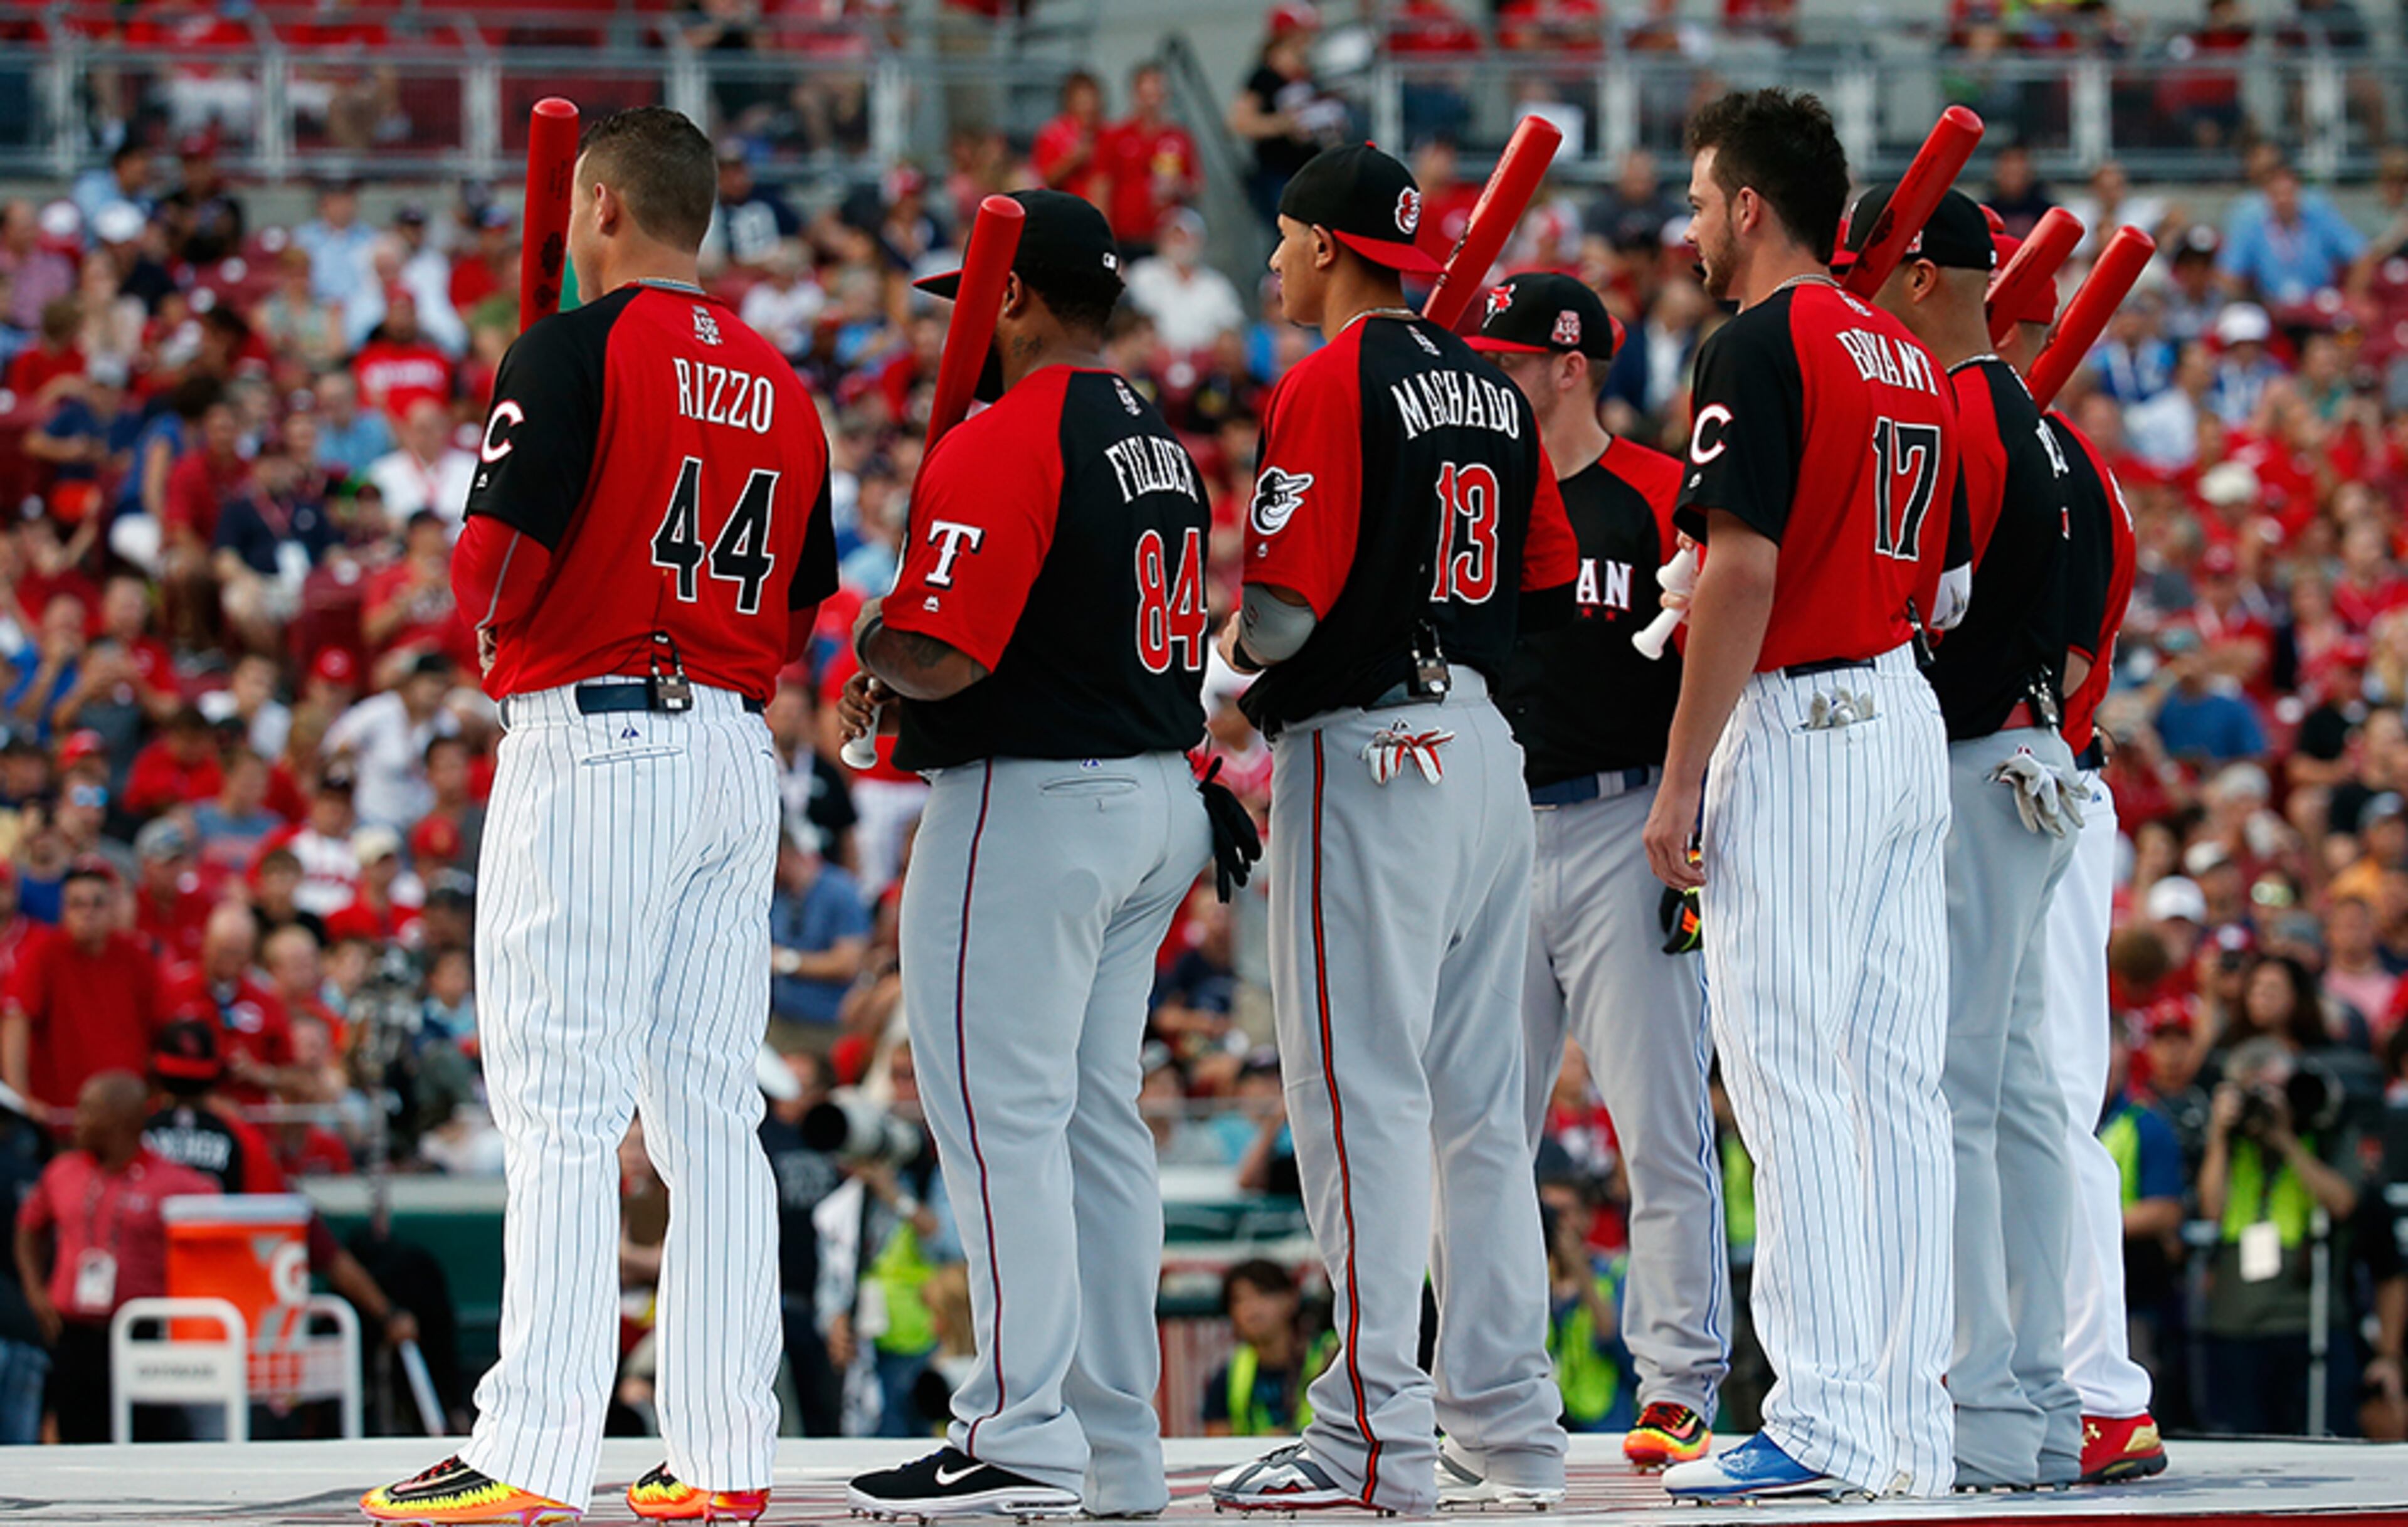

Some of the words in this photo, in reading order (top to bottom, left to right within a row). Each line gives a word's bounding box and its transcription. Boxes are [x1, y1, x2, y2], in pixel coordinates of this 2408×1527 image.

[673, 357, 774, 434] RIZZO
[1835, 327, 1939, 396] BRYANT
[481, 399, 525, 464] C
[1390, 369, 1519, 440] MACHADO
[1688, 403, 1733, 465] C
[1872, 416, 1941, 561] 17
[650, 456, 780, 615] 44
[925, 519, 985, 590] T
[1430, 460, 1499, 605] 13
[1134, 527, 1208, 675] 84
